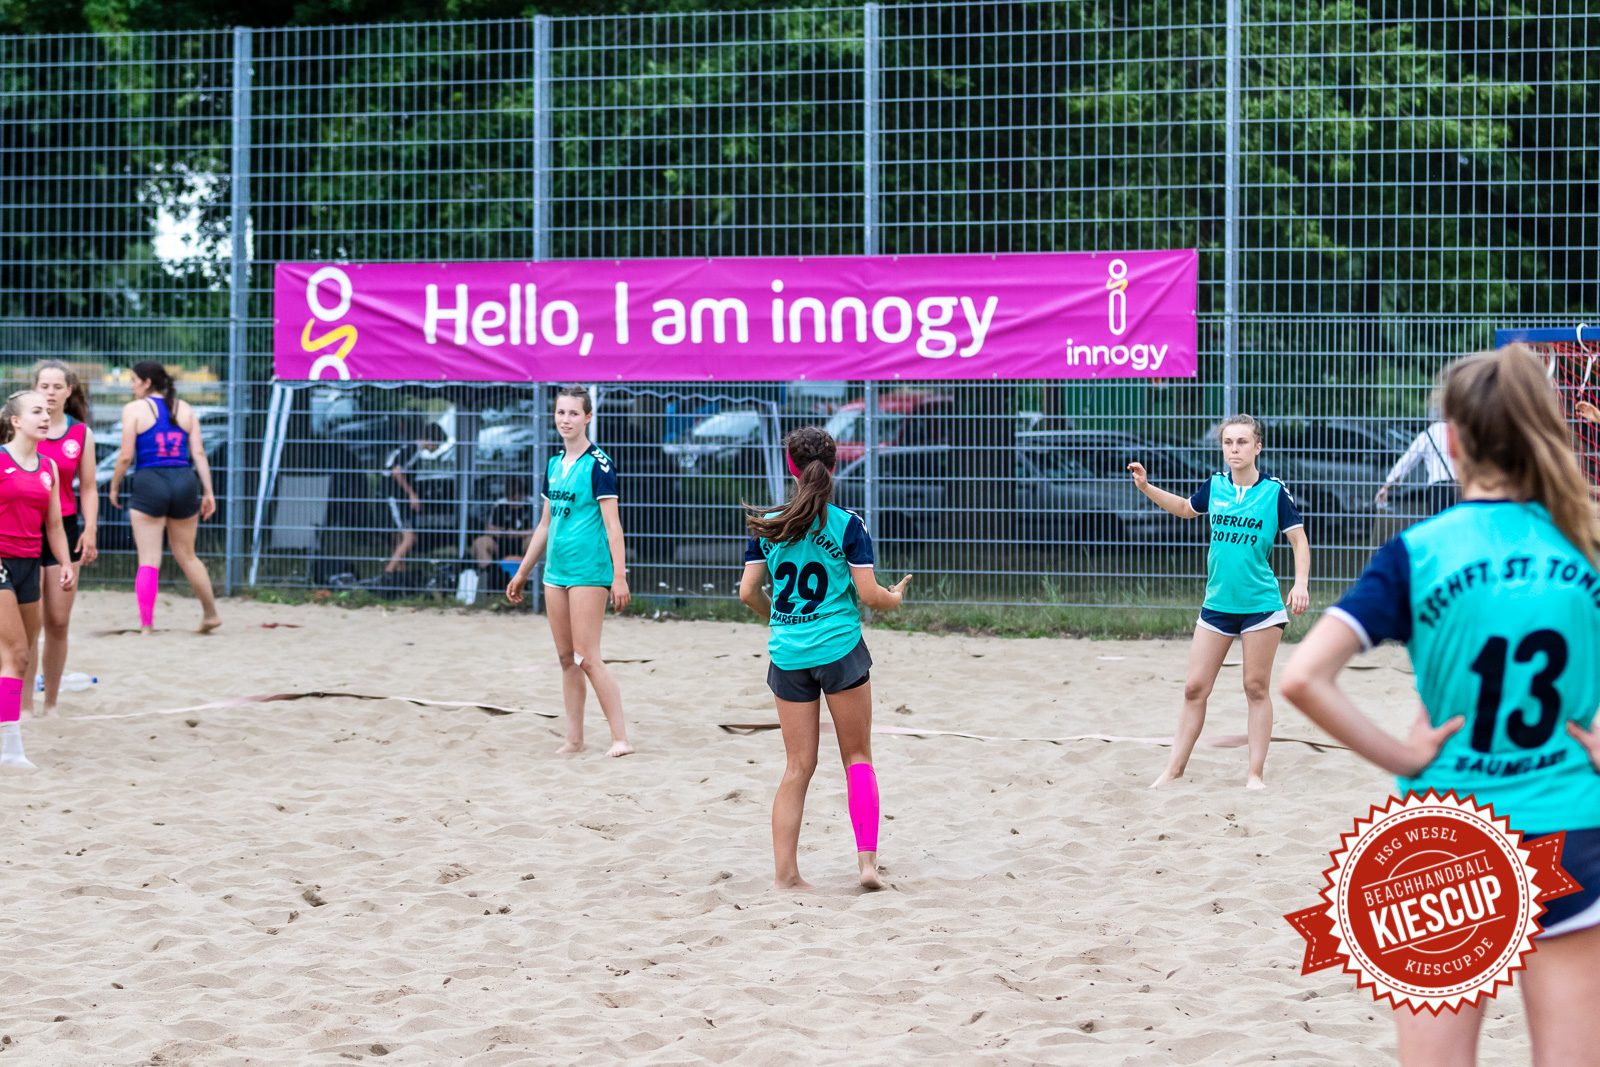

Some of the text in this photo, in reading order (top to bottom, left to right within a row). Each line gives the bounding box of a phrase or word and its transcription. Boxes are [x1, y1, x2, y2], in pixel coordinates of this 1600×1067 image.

[424, 279, 999, 359] Hello, I am innogy
[1066, 338, 1169, 371] innogy
[155, 431, 182, 457] 17
[1211, 514, 1264, 531] OBERLIGA
[1213, 530, 1258, 546] 2018/19
[774, 561, 828, 615] 29
[771, 611, 820, 624] MARSEILLE
[1468, 628, 1569, 754] 13
